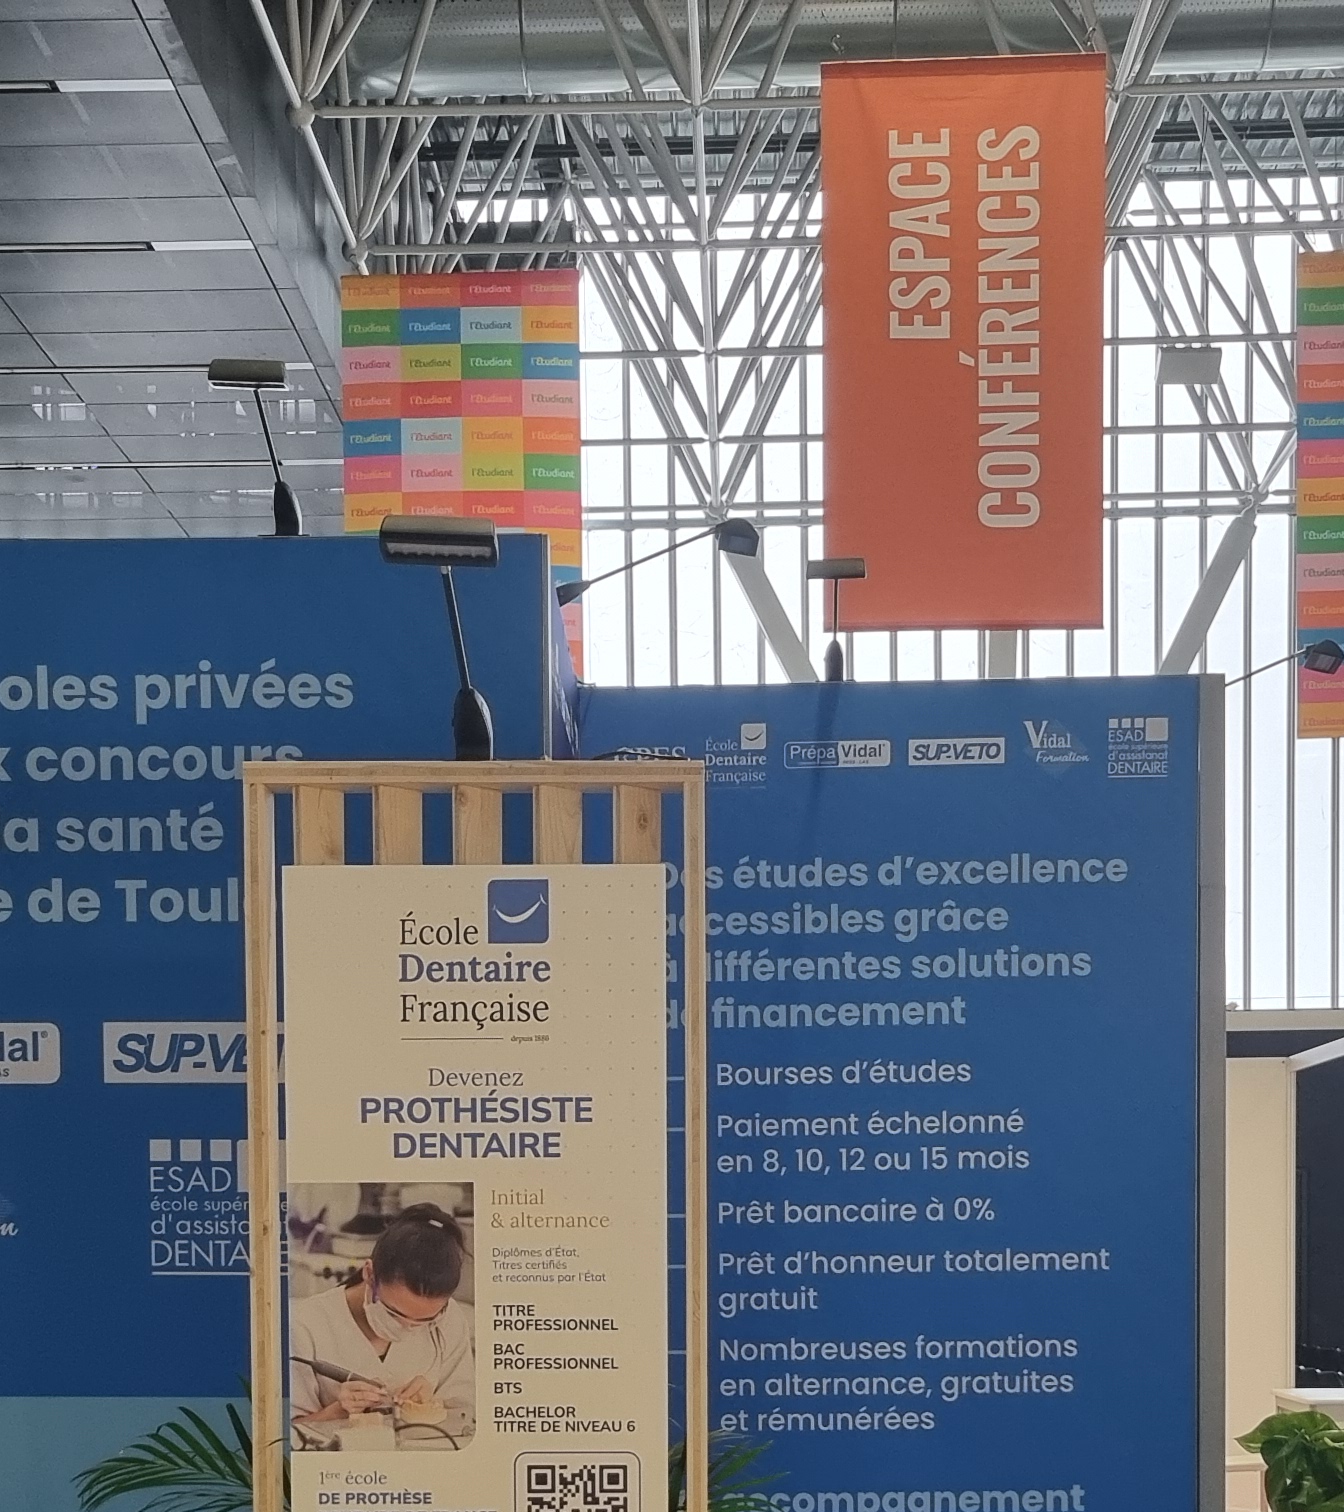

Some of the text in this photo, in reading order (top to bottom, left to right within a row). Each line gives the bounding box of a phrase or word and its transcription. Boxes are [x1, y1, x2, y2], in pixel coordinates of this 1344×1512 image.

[888, 128, 950, 339] ESPACE
[958, 125, 1040, 528] CONFÉRENCES
[135, 658, 354, 724] privées
[706, 737, 737, 750] École
[1023, 720, 1071, 748] Vidal
[1108, 730, 1143, 742] ESAD
[706, 753, 766, 766] Dentaire
[791, 745, 835, 765] Prépa
[912, 742, 1001, 761] SUP-VETO
[706, 770, 765, 784] Française
[1108, 762, 1168, 774] DENTAIRE
[56, 801, 224, 852] santé
[733, 856, 868, 889] études
[877, 853, 1128, 887] d'excellence
[27, 878, 101, 922] de
[400, 912, 478, 946] École
[894, 900, 1009, 943] grâce
[399, 952, 551, 983] Dentaire
[706, 948, 901, 983] ifférentes
[912, 945, 1091, 978] solutions
[400, 994, 549, 1030] Française
[711, 995, 966, 1029] financement
[428, 1067, 523, 1087] Devenez
[716, 1059, 971, 1086] Bourses d'études
[360, 1090, 593, 1124] PROTHÉSISTE
[717, 1108, 1024, 1137] Paiement échelonné
[393, 1132, 561, 1158] DENTAIRE
[717, 1145, 1030, 1176] en 8, 10, 12 ou 15 mois
[150, 1167, 231, 1192] ESAD
[150, 1196, 198, 1211] école
[491, 1189, 544, 1205] Initial
[511, 1212, 610, 1228] alternance
[718, 1197, 995, 1224] Prêt bancaire à 0%
[492, 1248, 542, 1259] Diplômes
[492, 1259, 567, 1270] Titres certifiés
[719, 1247, 1110, 1275] Prêt d'honneur totalement
[506, 1274, 554, 1282] reconnus
[493, 1305, 535, 1316] TITRE
[718, 1287, 818, 1318] gratuit
[493, 1319, 618, 1331] PROFESSIONNEL
[493, 1344, 524, 1355] BAC
[719, 1334, 1078, 1362] Nombreuses formations
[493, 1358, 618, 1370] PROFESSIONNEL
[494, 1382, 522, 1394] BTS
[719, 1370, 1074, 1402] en alternance, gratuites
[494, 1406, 576, 1418] BACHELOR
[720, 1406, 935, 1433] et rémunérées
[494, 1421, 622, 1432] TITRE DE NIVEAU
[345, 1471, 387, 1485] école
[319, 1489, 432, 1505] DE PROTHÈSE
